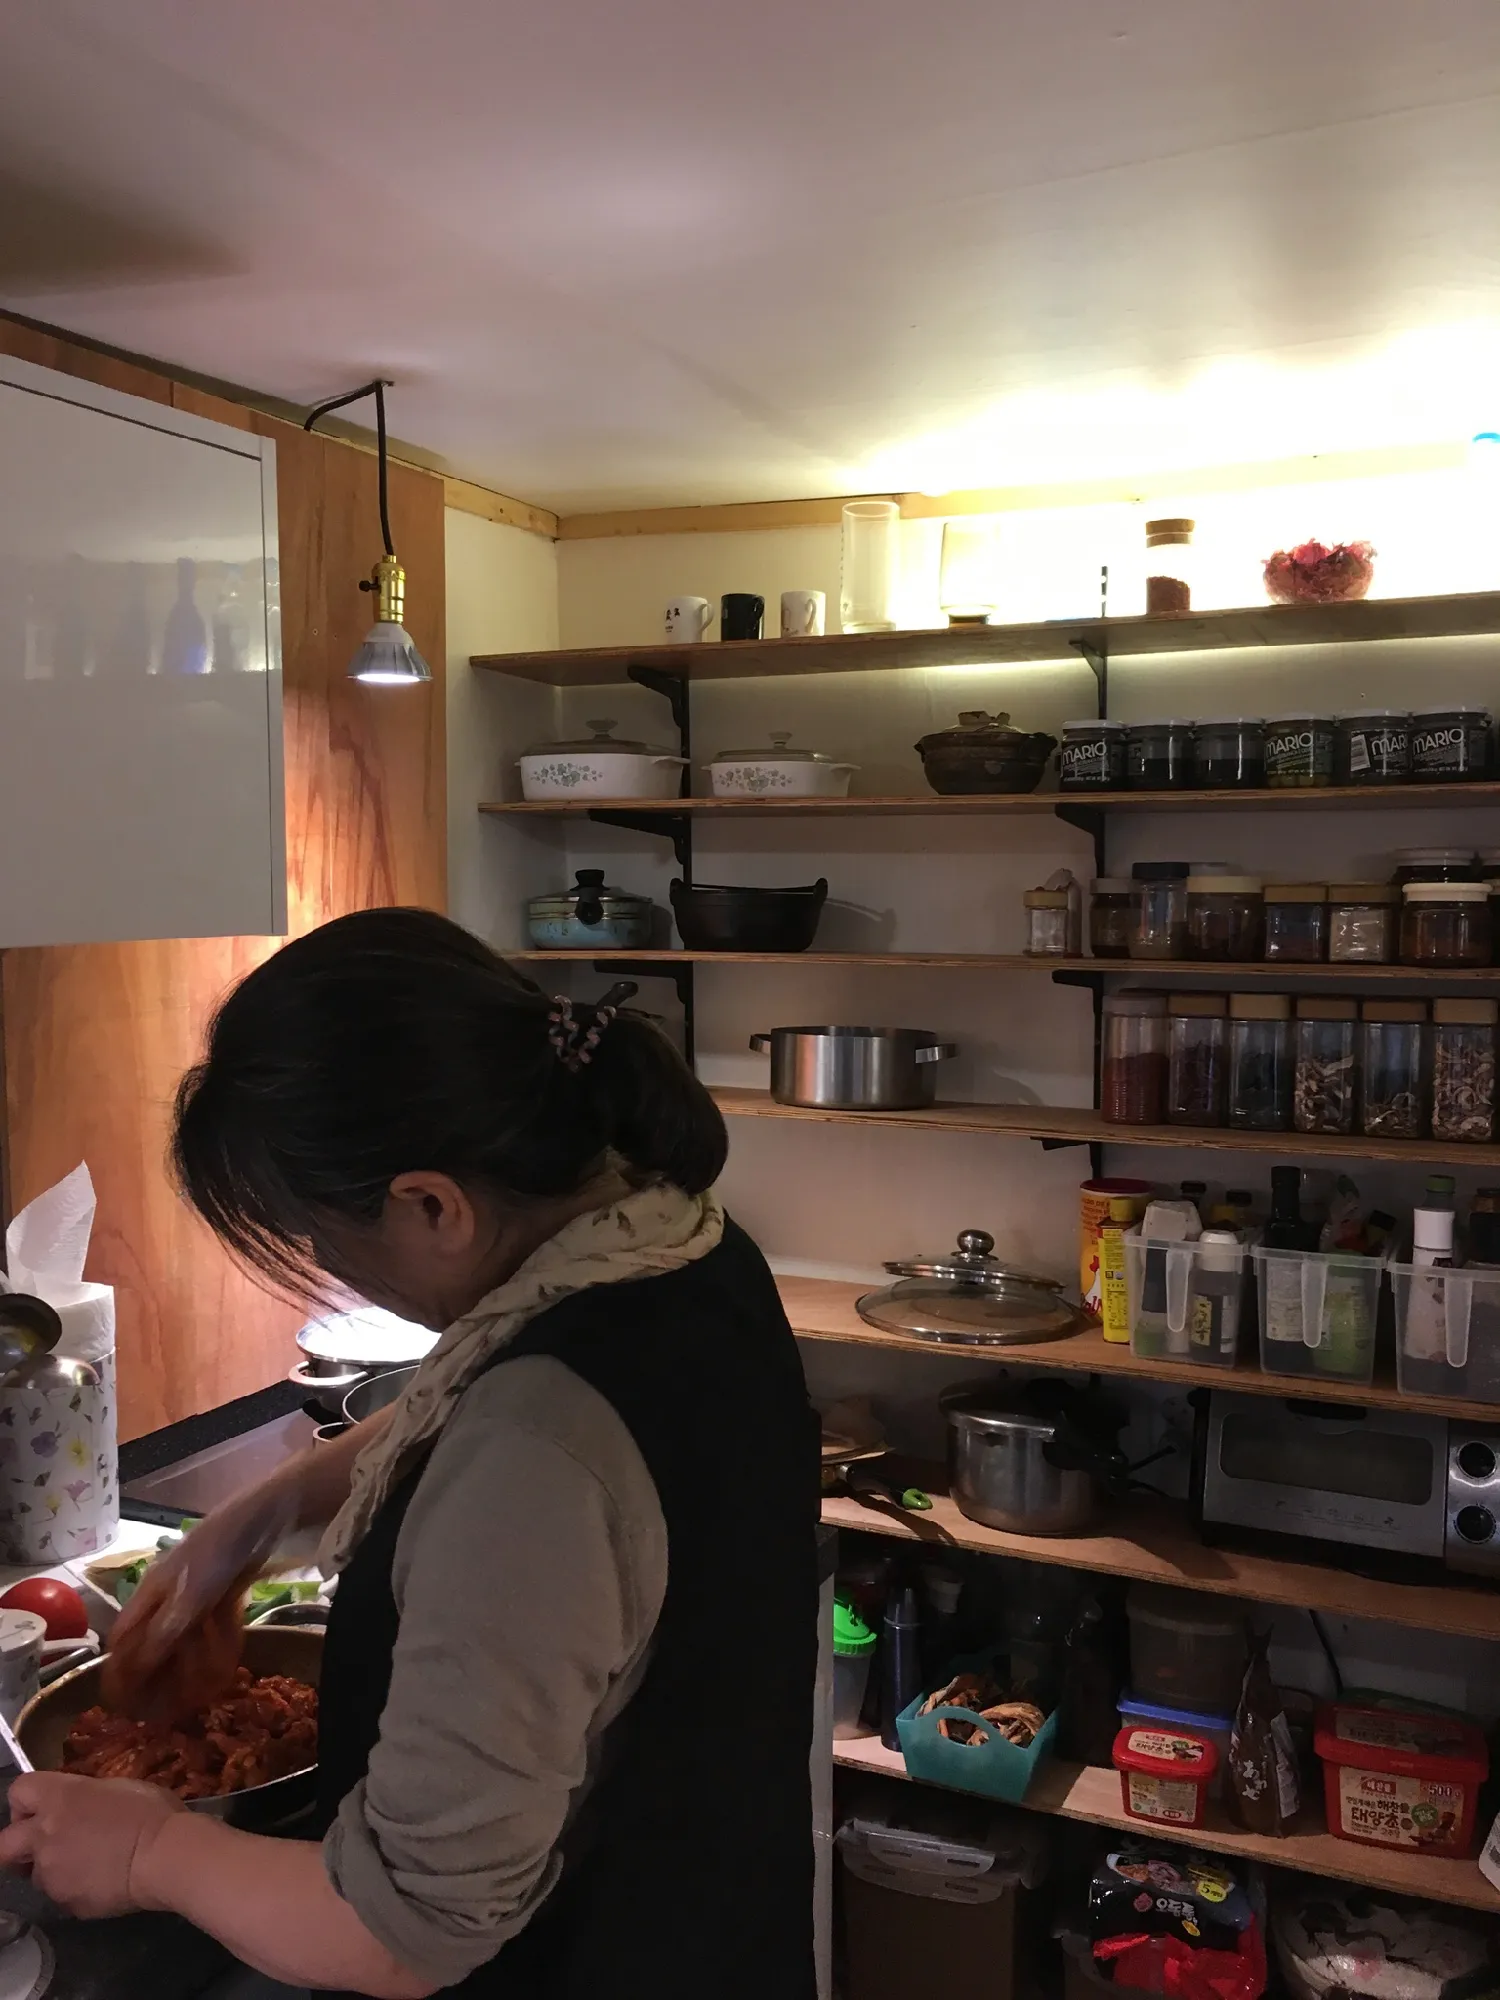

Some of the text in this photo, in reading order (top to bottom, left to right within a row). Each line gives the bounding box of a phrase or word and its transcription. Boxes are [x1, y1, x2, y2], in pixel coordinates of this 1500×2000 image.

[1062, 741, 1107, 766] MARIO
[1266, 732, 1314, 758] MARIO
[1413, 728, 1464, 756] MARIO
[1429, 1784, 1453, 1797] 500
[1351, 1806, 1399, 1828] 태양초
[1202, 1883, 1210, 1894] 5
